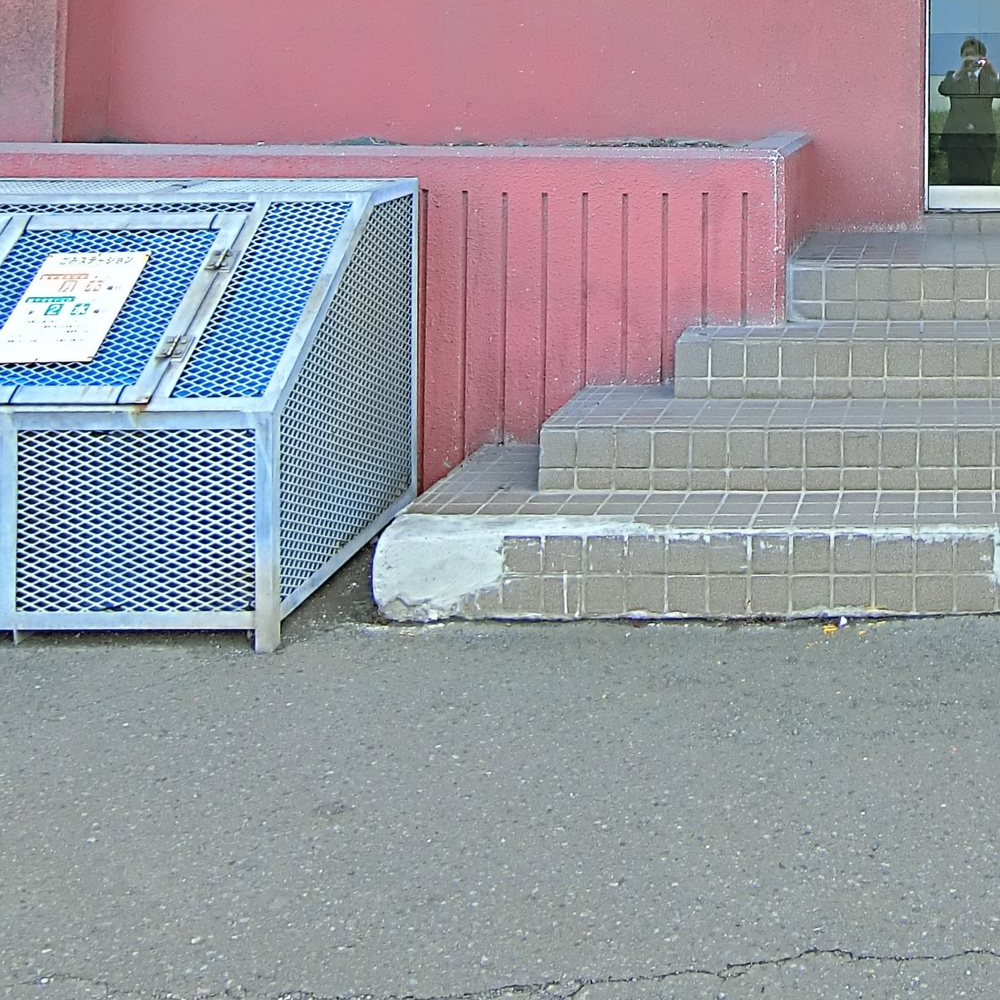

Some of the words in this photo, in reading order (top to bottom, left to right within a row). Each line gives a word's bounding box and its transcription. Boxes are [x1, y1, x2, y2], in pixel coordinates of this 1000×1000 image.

[60, 256, 134, 265] ごみステーション
